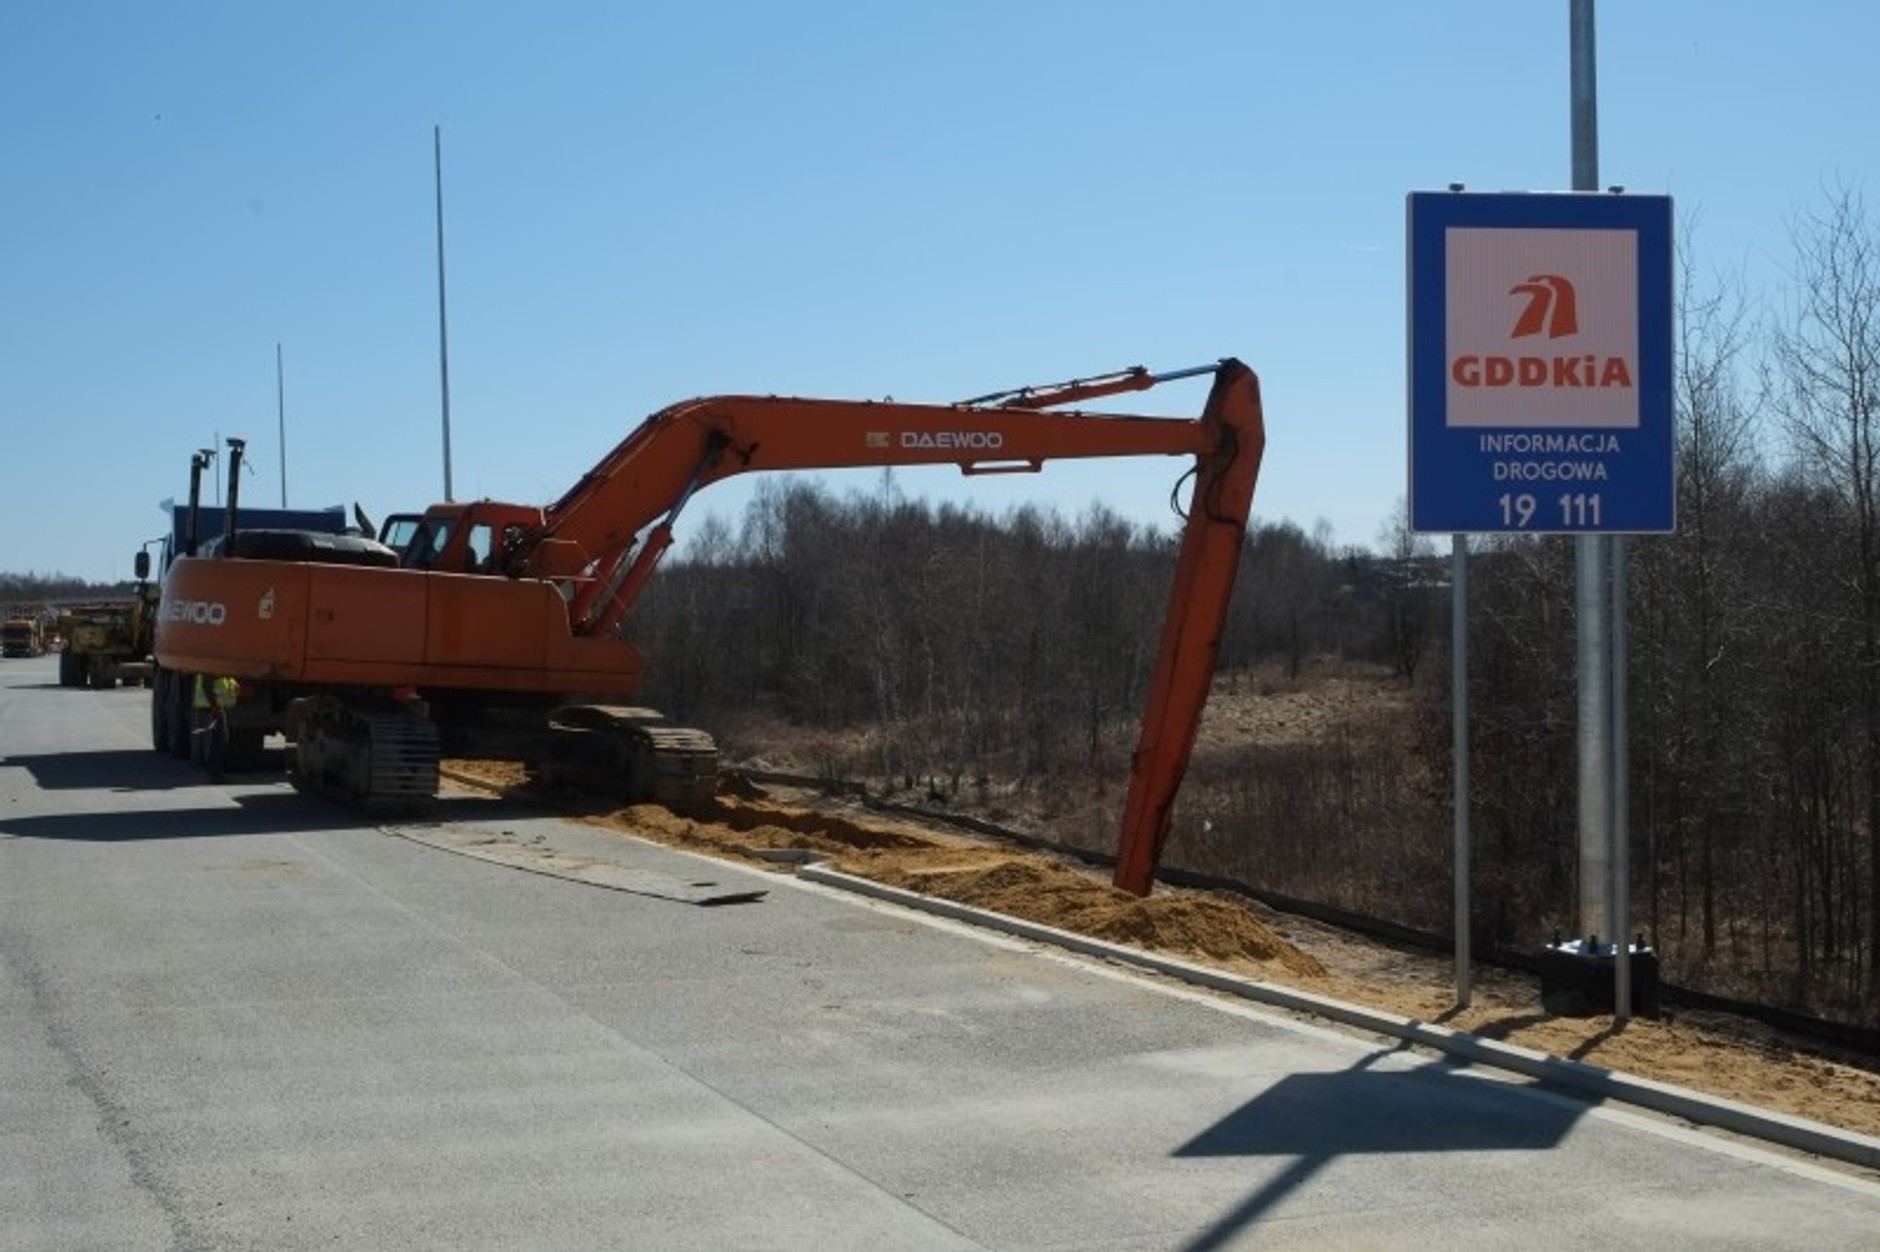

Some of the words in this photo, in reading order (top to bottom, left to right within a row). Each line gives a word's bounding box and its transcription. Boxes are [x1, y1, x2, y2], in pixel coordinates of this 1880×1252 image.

[1452, 355, 1632, 388] GDDKiA
[901, 432, 1002, 448] DAEWOO
[1480, 434, 1620, 452] INFORMACJA
[1494, 462, 1608, 480] DROGOWA
[1500, 493, 1537, 527] 19
[1559, 493, 1601, 526] 111
[160, 600, 227, 626] EWOO
